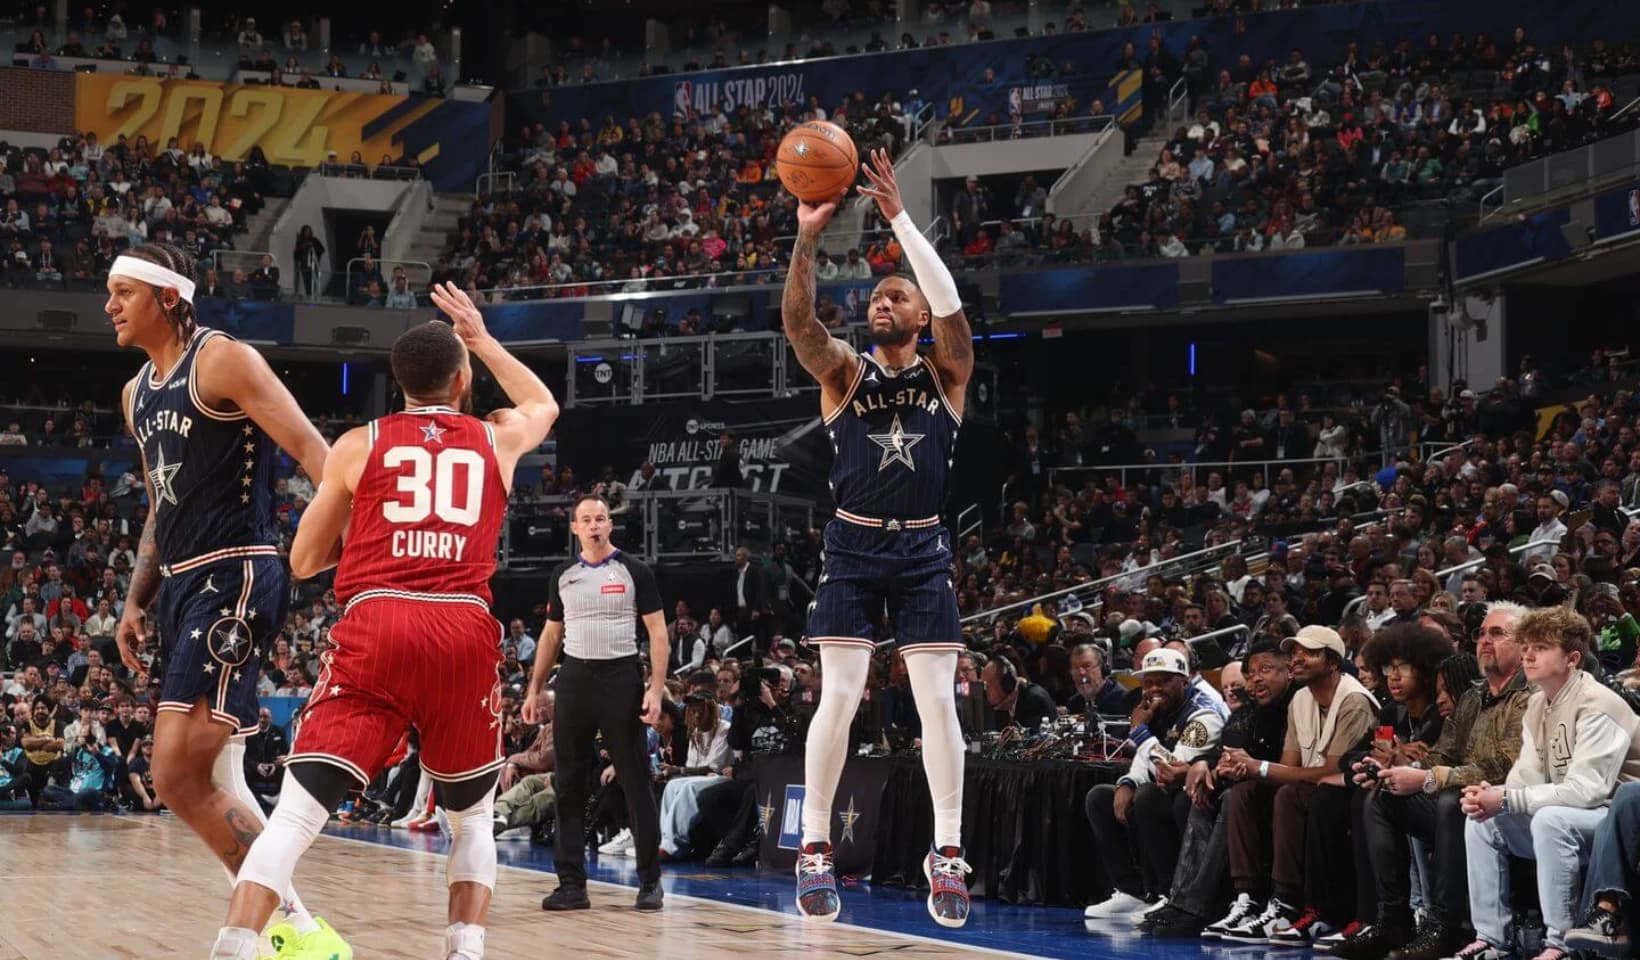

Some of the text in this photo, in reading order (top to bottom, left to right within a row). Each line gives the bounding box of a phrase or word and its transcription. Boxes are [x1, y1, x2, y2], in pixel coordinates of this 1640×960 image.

[768, 73, 805, 109] 2024
[97, 81, 330, 168] 2024
[853, 387, 940, 417] ALL-STAR
[649, 442, 674, 463] NBA
[739, 438, 778, 459] GAME
[383, 446, 486, 527] 30
[391, 530, 467, 562] CURRY
